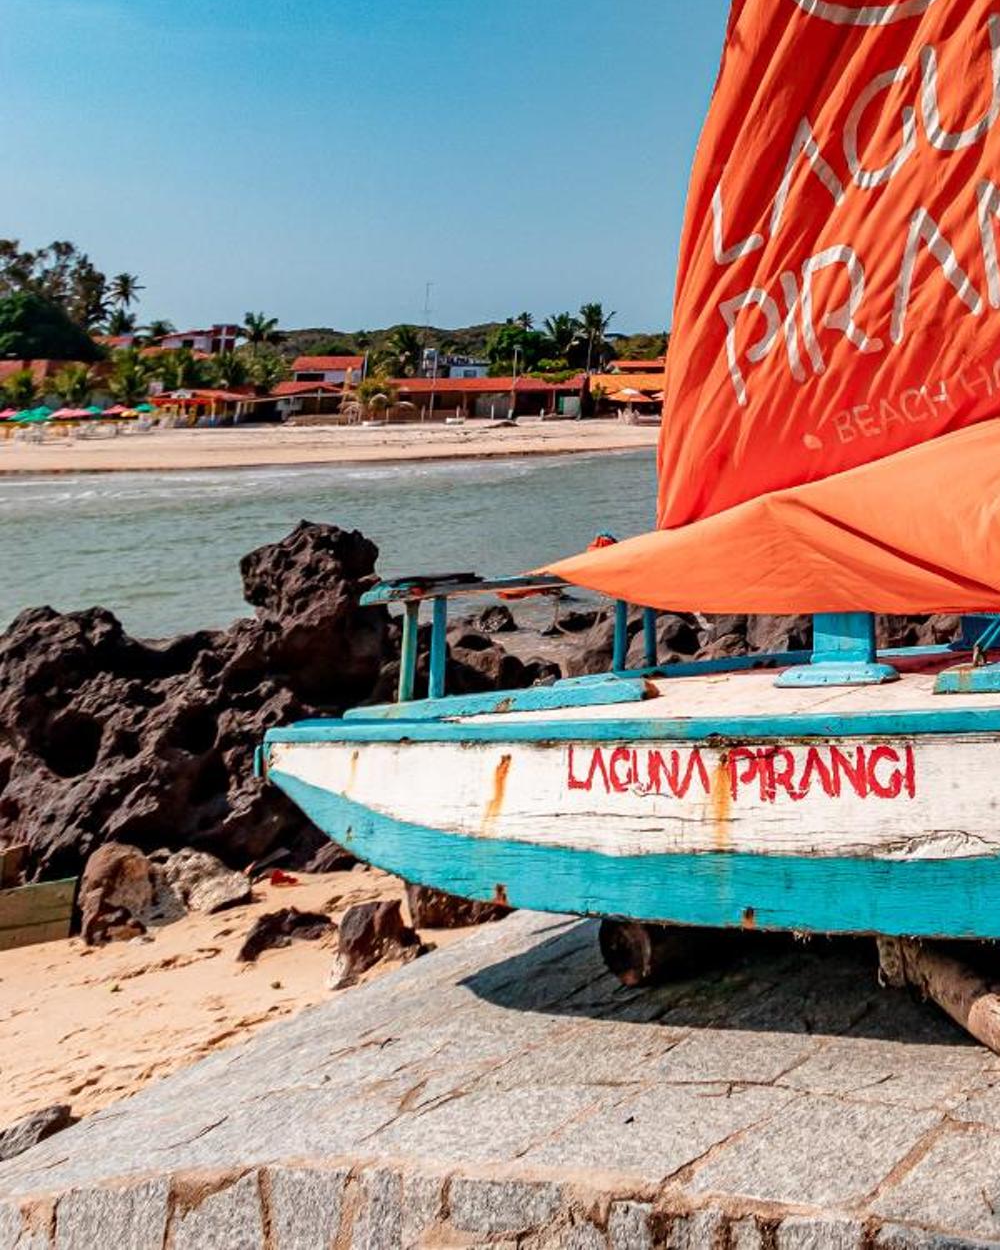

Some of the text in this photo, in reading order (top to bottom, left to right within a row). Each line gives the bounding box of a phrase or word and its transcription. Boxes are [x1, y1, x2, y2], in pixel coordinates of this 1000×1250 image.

[832, 381, 953, 445] BEACH
[567, 744, 916, 803] LAGUNA PIRANGI
